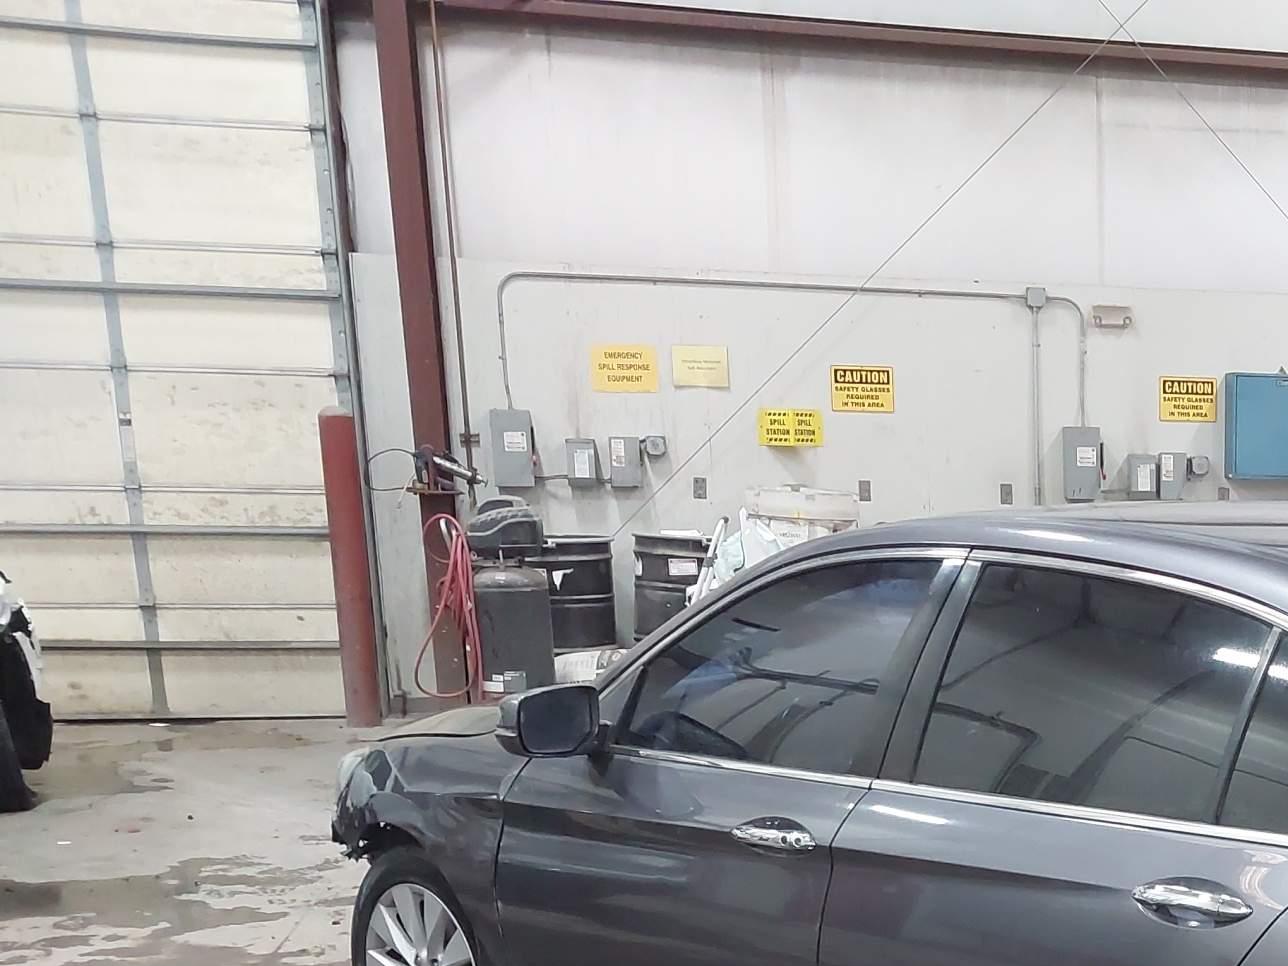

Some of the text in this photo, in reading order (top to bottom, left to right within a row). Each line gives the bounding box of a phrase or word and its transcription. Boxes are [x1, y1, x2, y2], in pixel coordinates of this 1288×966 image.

[604, 351, 643, 360] EMERGENCY
[598, 363, 650, 371] SPILL RESPONSE
[607, 375, 643, 383] EQUIPMENT
[836, 370, 888, 384] CAUTION
[1165, 381, 1212, 394] CAUTION
[769, 418, 786, 426] SPILL
[766, 428, 790, 436] STATION
[794, 429, 816, 437] STATION
